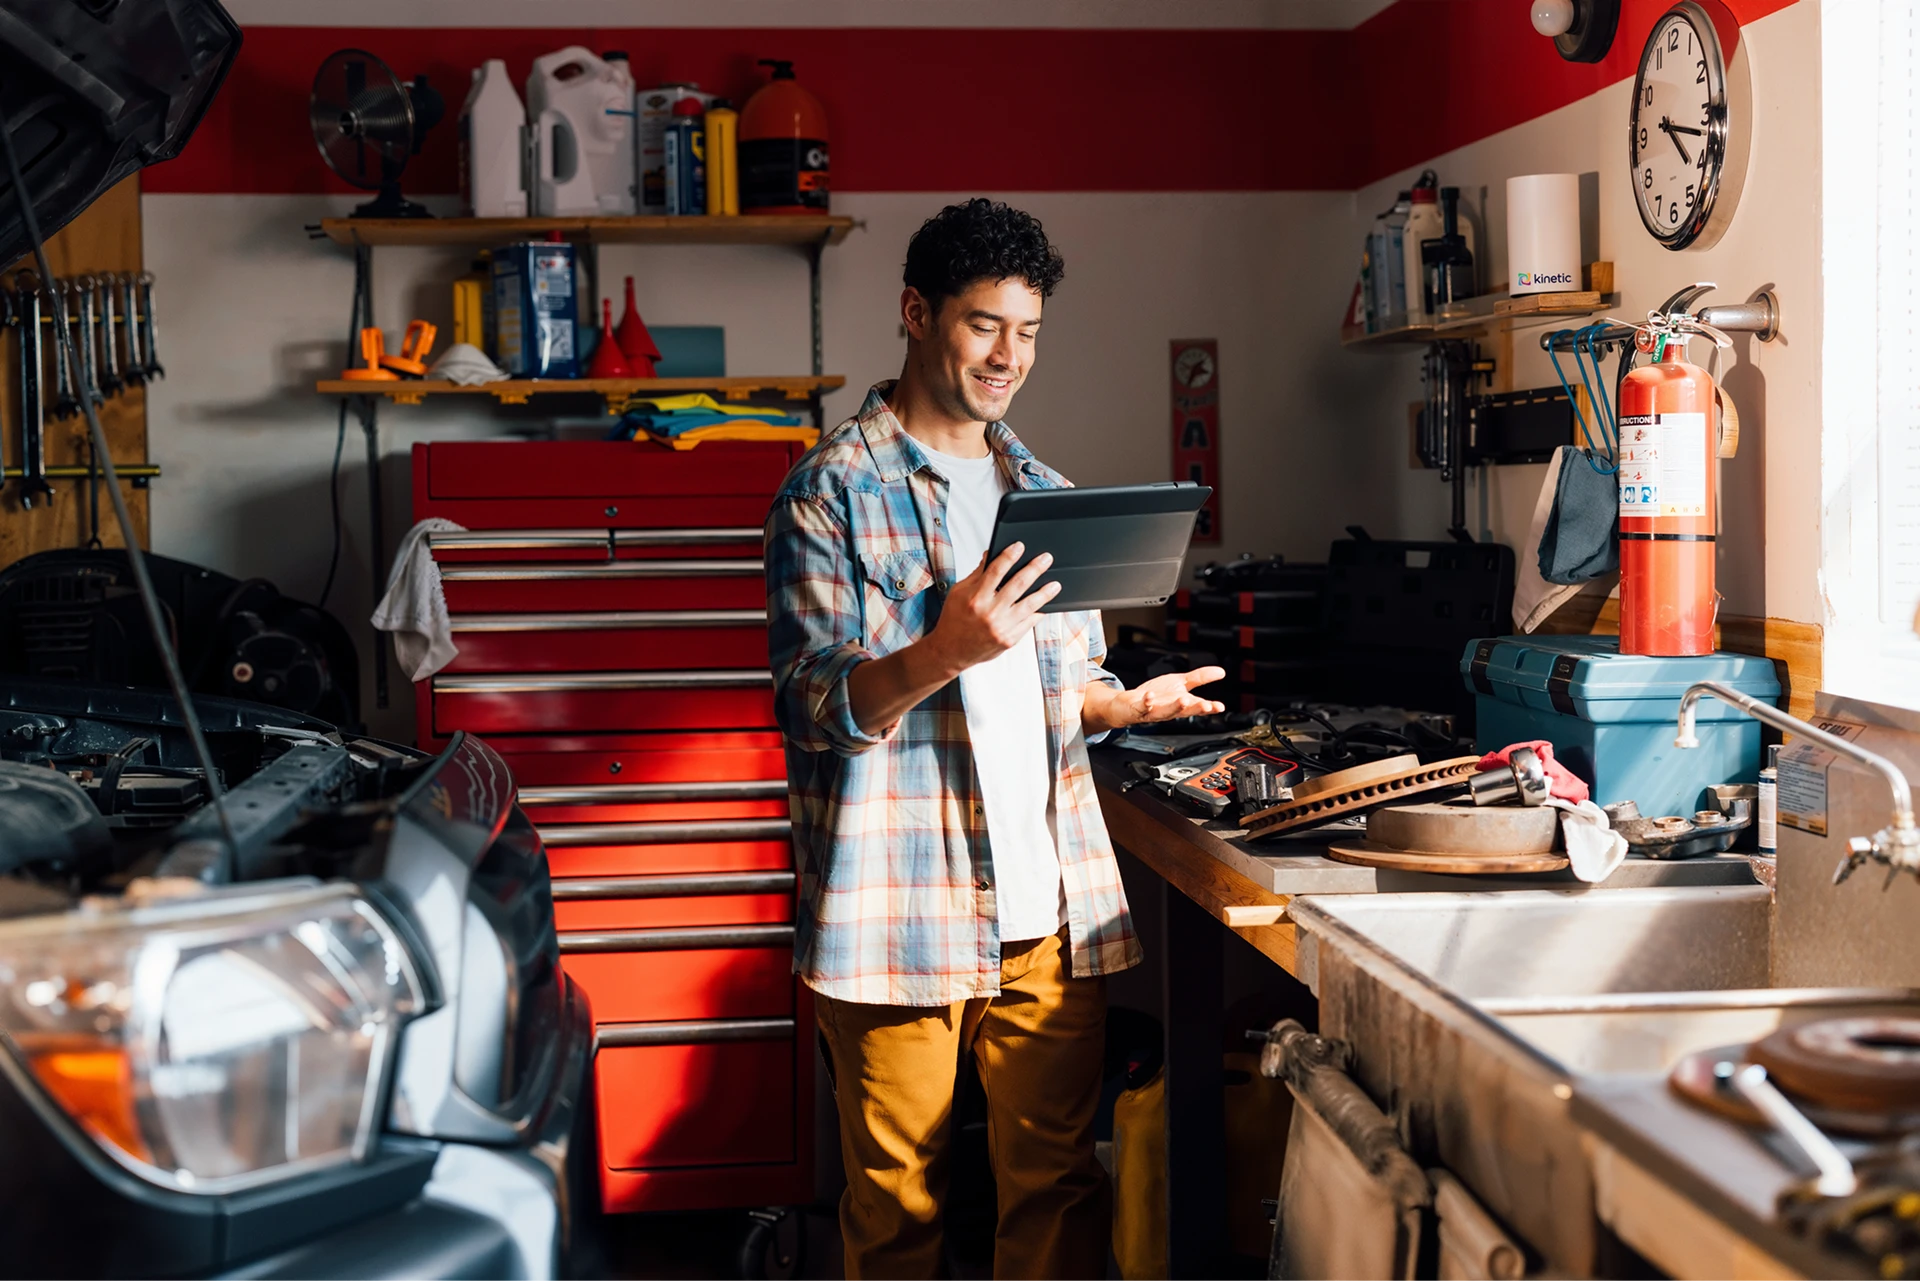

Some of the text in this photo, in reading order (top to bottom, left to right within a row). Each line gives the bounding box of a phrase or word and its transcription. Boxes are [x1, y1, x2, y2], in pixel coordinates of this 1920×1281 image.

[1667, 28, 1679, 53] 12
[1687, 32, 1692, 55] 1
[1656, 47, 1663, 71] 11
[1696, 60, 1706, 84] 2
[1644, 85, 1653, 108] 10
[1700, 102, 1711, 126] 3
[1640, 128, 1648, 150] 9
[1696, 149, 1706, 170] 4
[1644, 168, 1653, 189] 8
[1654, 195, 1662, 217] 7
[1685, 184, 1695, 208] 5
[1669, 202, 1679, 224] 6
[1533, 273, 1572, 284] kinetic
